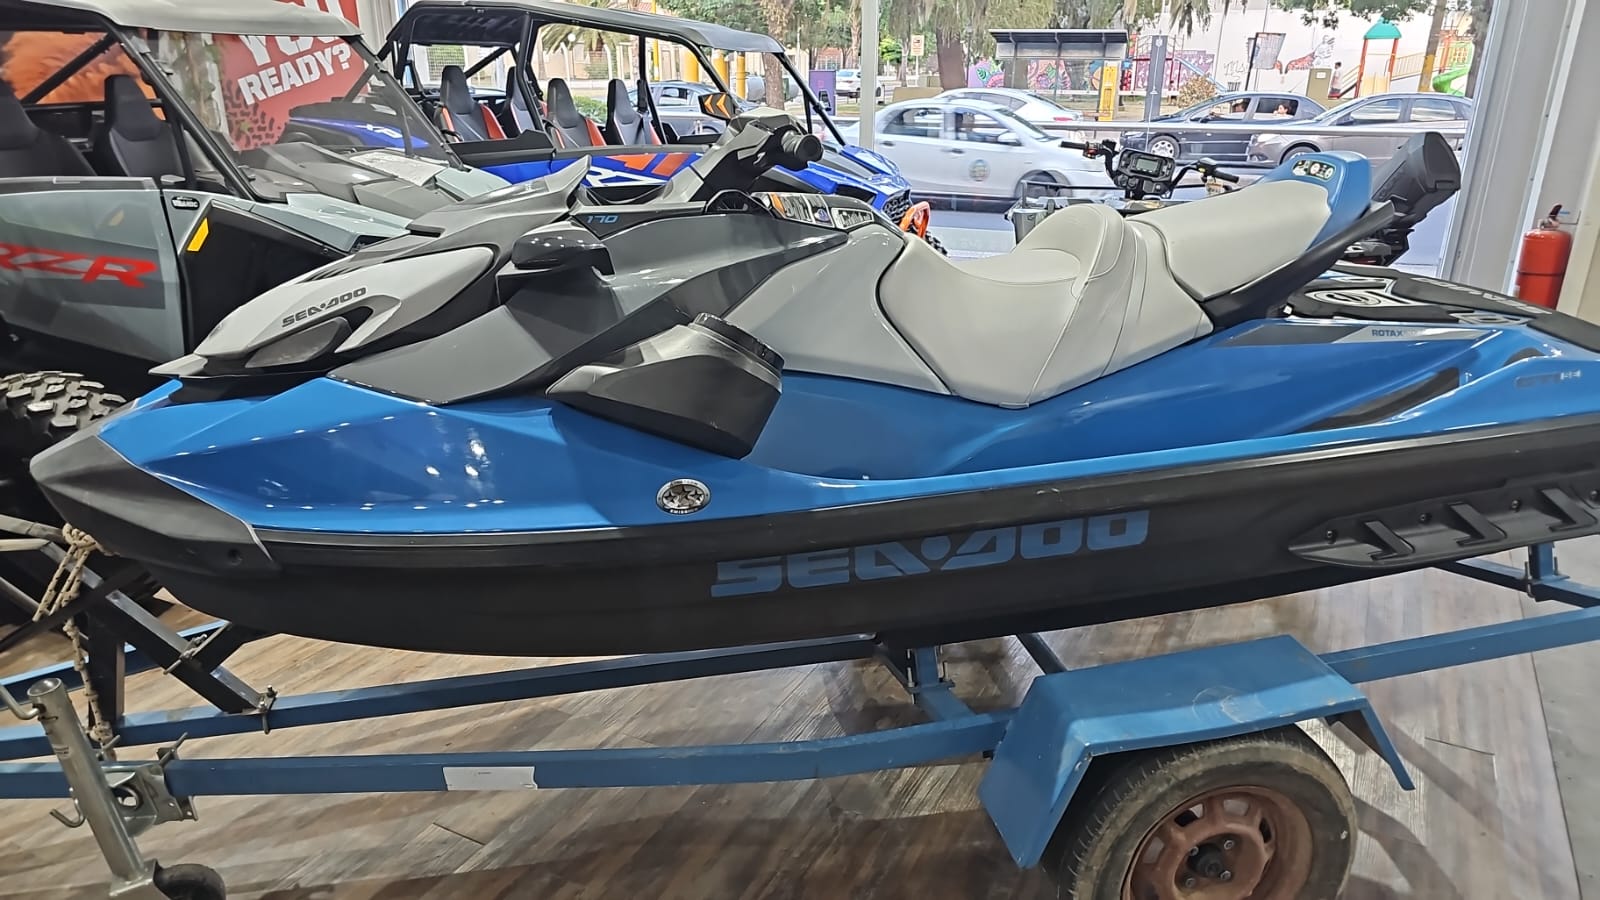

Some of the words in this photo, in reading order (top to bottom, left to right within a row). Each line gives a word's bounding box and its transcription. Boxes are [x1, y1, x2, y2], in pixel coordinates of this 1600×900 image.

[237, 43, 351, 105] READY?
[586, 215, 619, 224] 170
[1371, 329, 1404, 337] ROTAX
